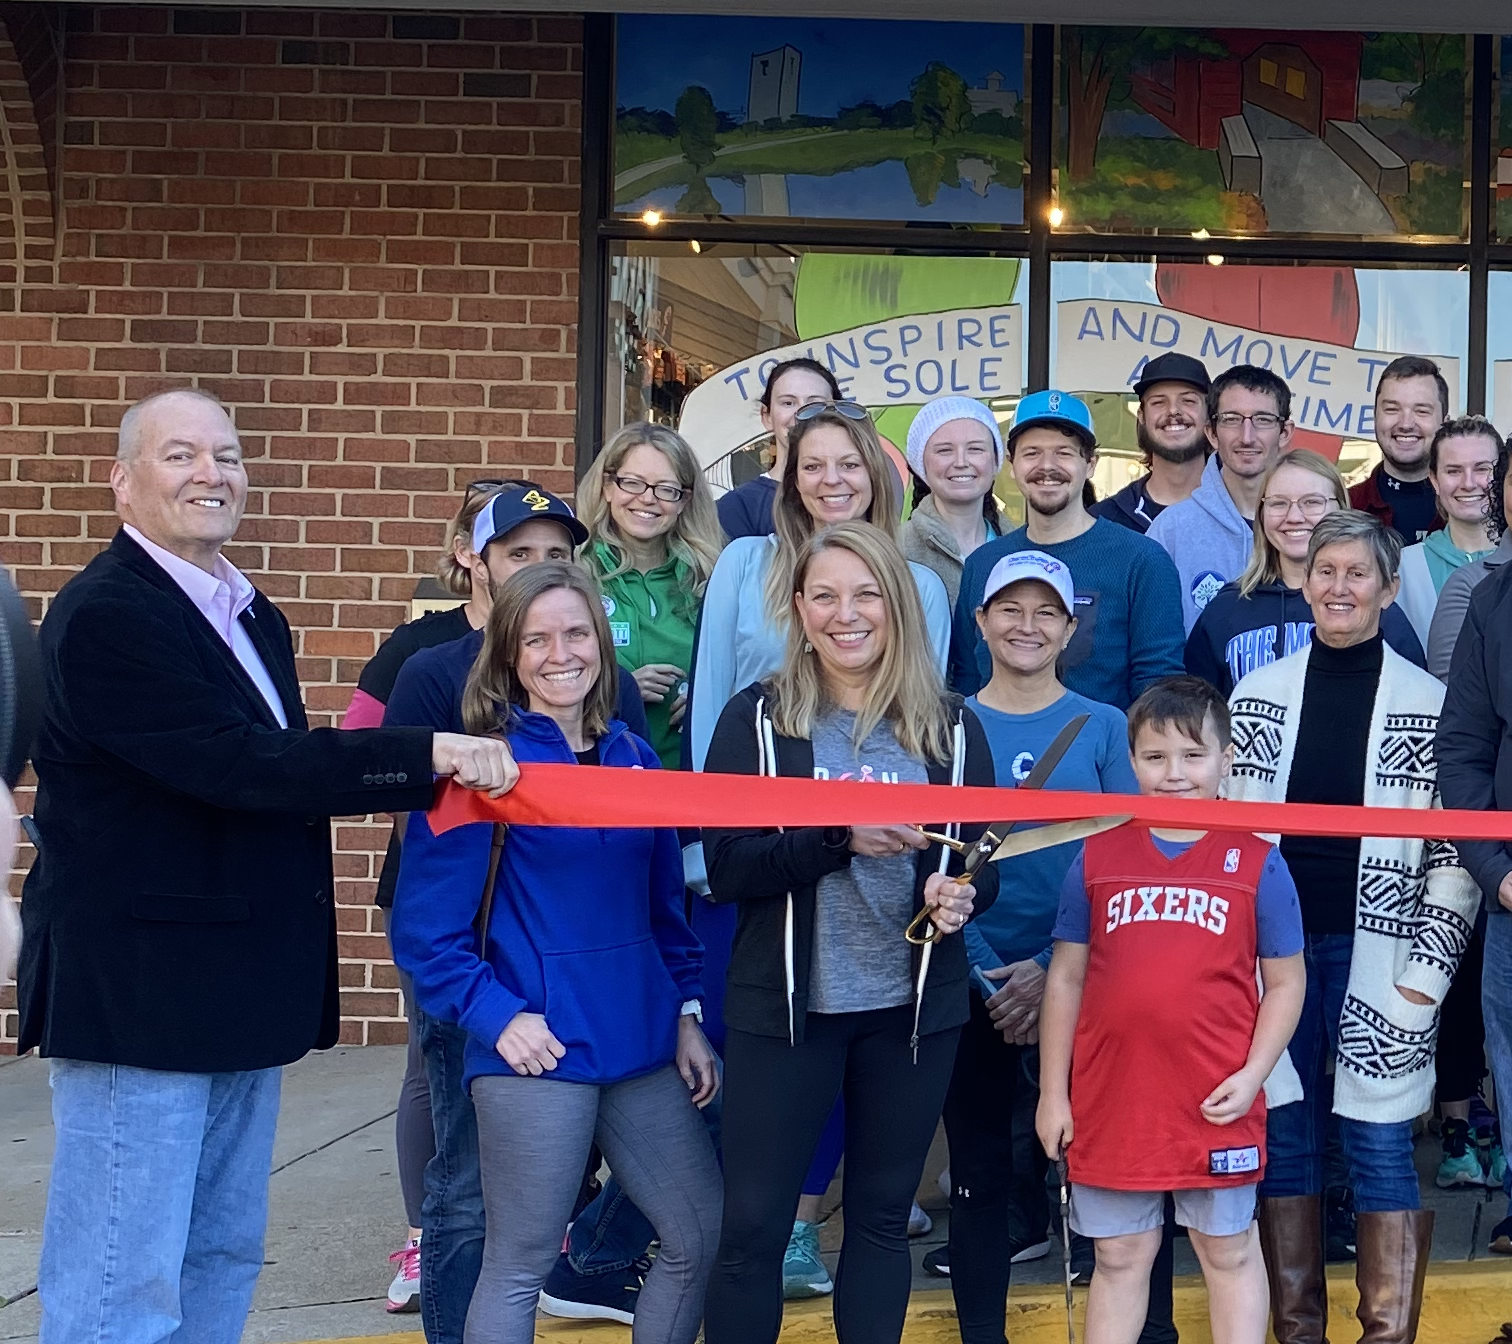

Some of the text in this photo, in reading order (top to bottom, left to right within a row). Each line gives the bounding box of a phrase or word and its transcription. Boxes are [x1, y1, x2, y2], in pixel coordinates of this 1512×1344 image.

[1077, 306, 1181, 348] AND
[1200, 326, 1338, 385] MOVE
[883, 357, 1003, 398] SOLE
[1291, 393, 1375, 433] IME
[1105, 885, 1230, 936] SIXERS
